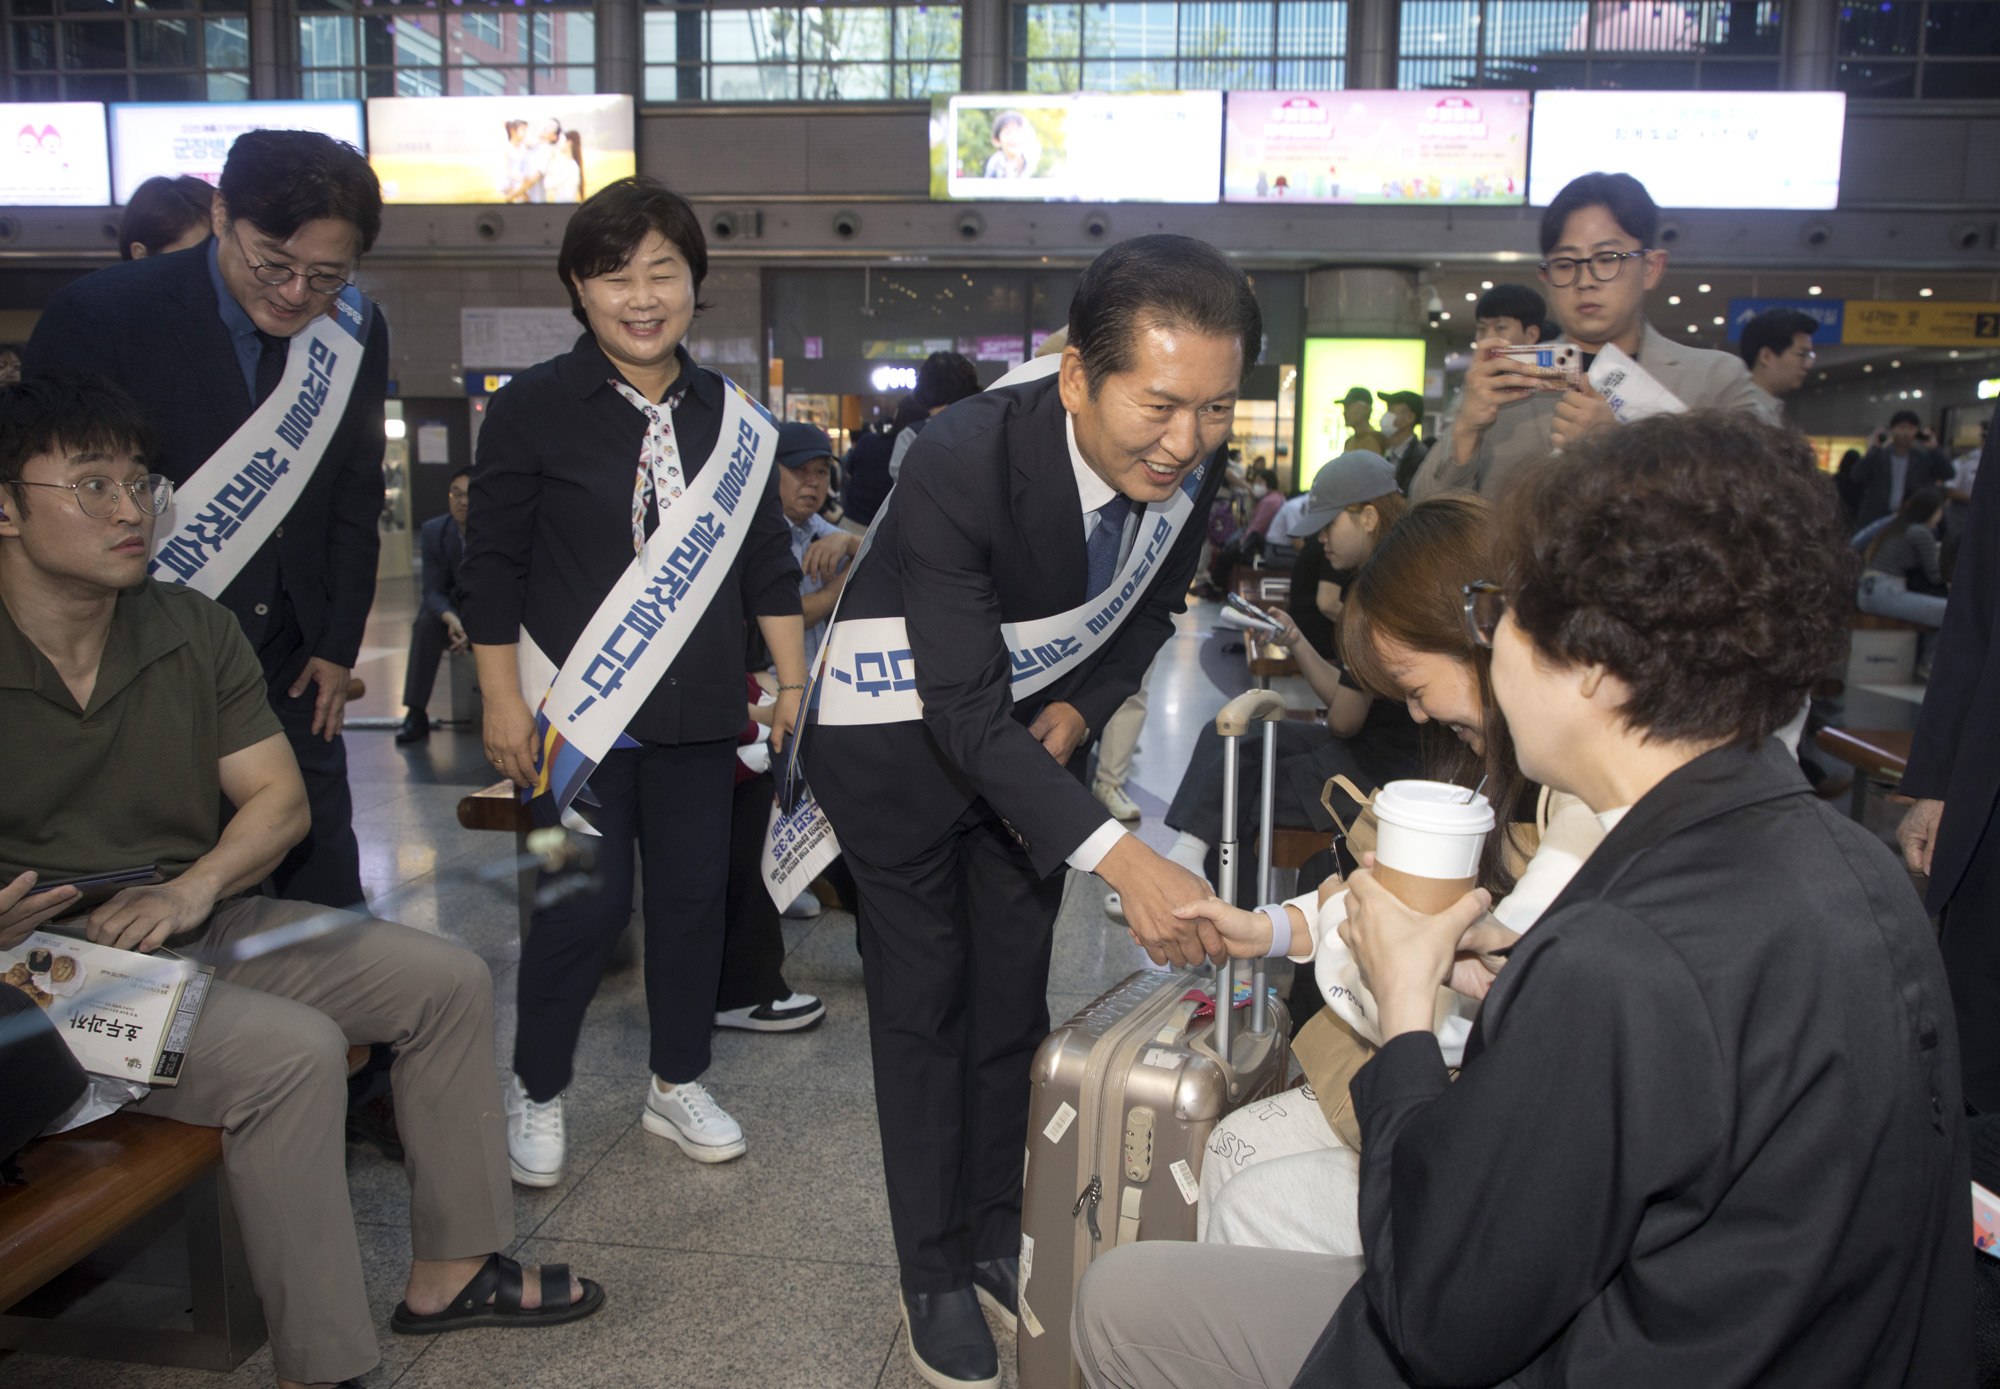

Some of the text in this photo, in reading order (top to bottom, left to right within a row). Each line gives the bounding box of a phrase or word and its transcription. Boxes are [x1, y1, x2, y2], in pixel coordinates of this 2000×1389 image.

[1982, 315, 1995, 335] 2
[274, 336, 338, 450] 민생을
[567, 416, 760, 723] 민생을 살리겠습니다!
[1085, 515, 1173, 636] 민생을
[70, 1010, 143, 1042] 호두과자
